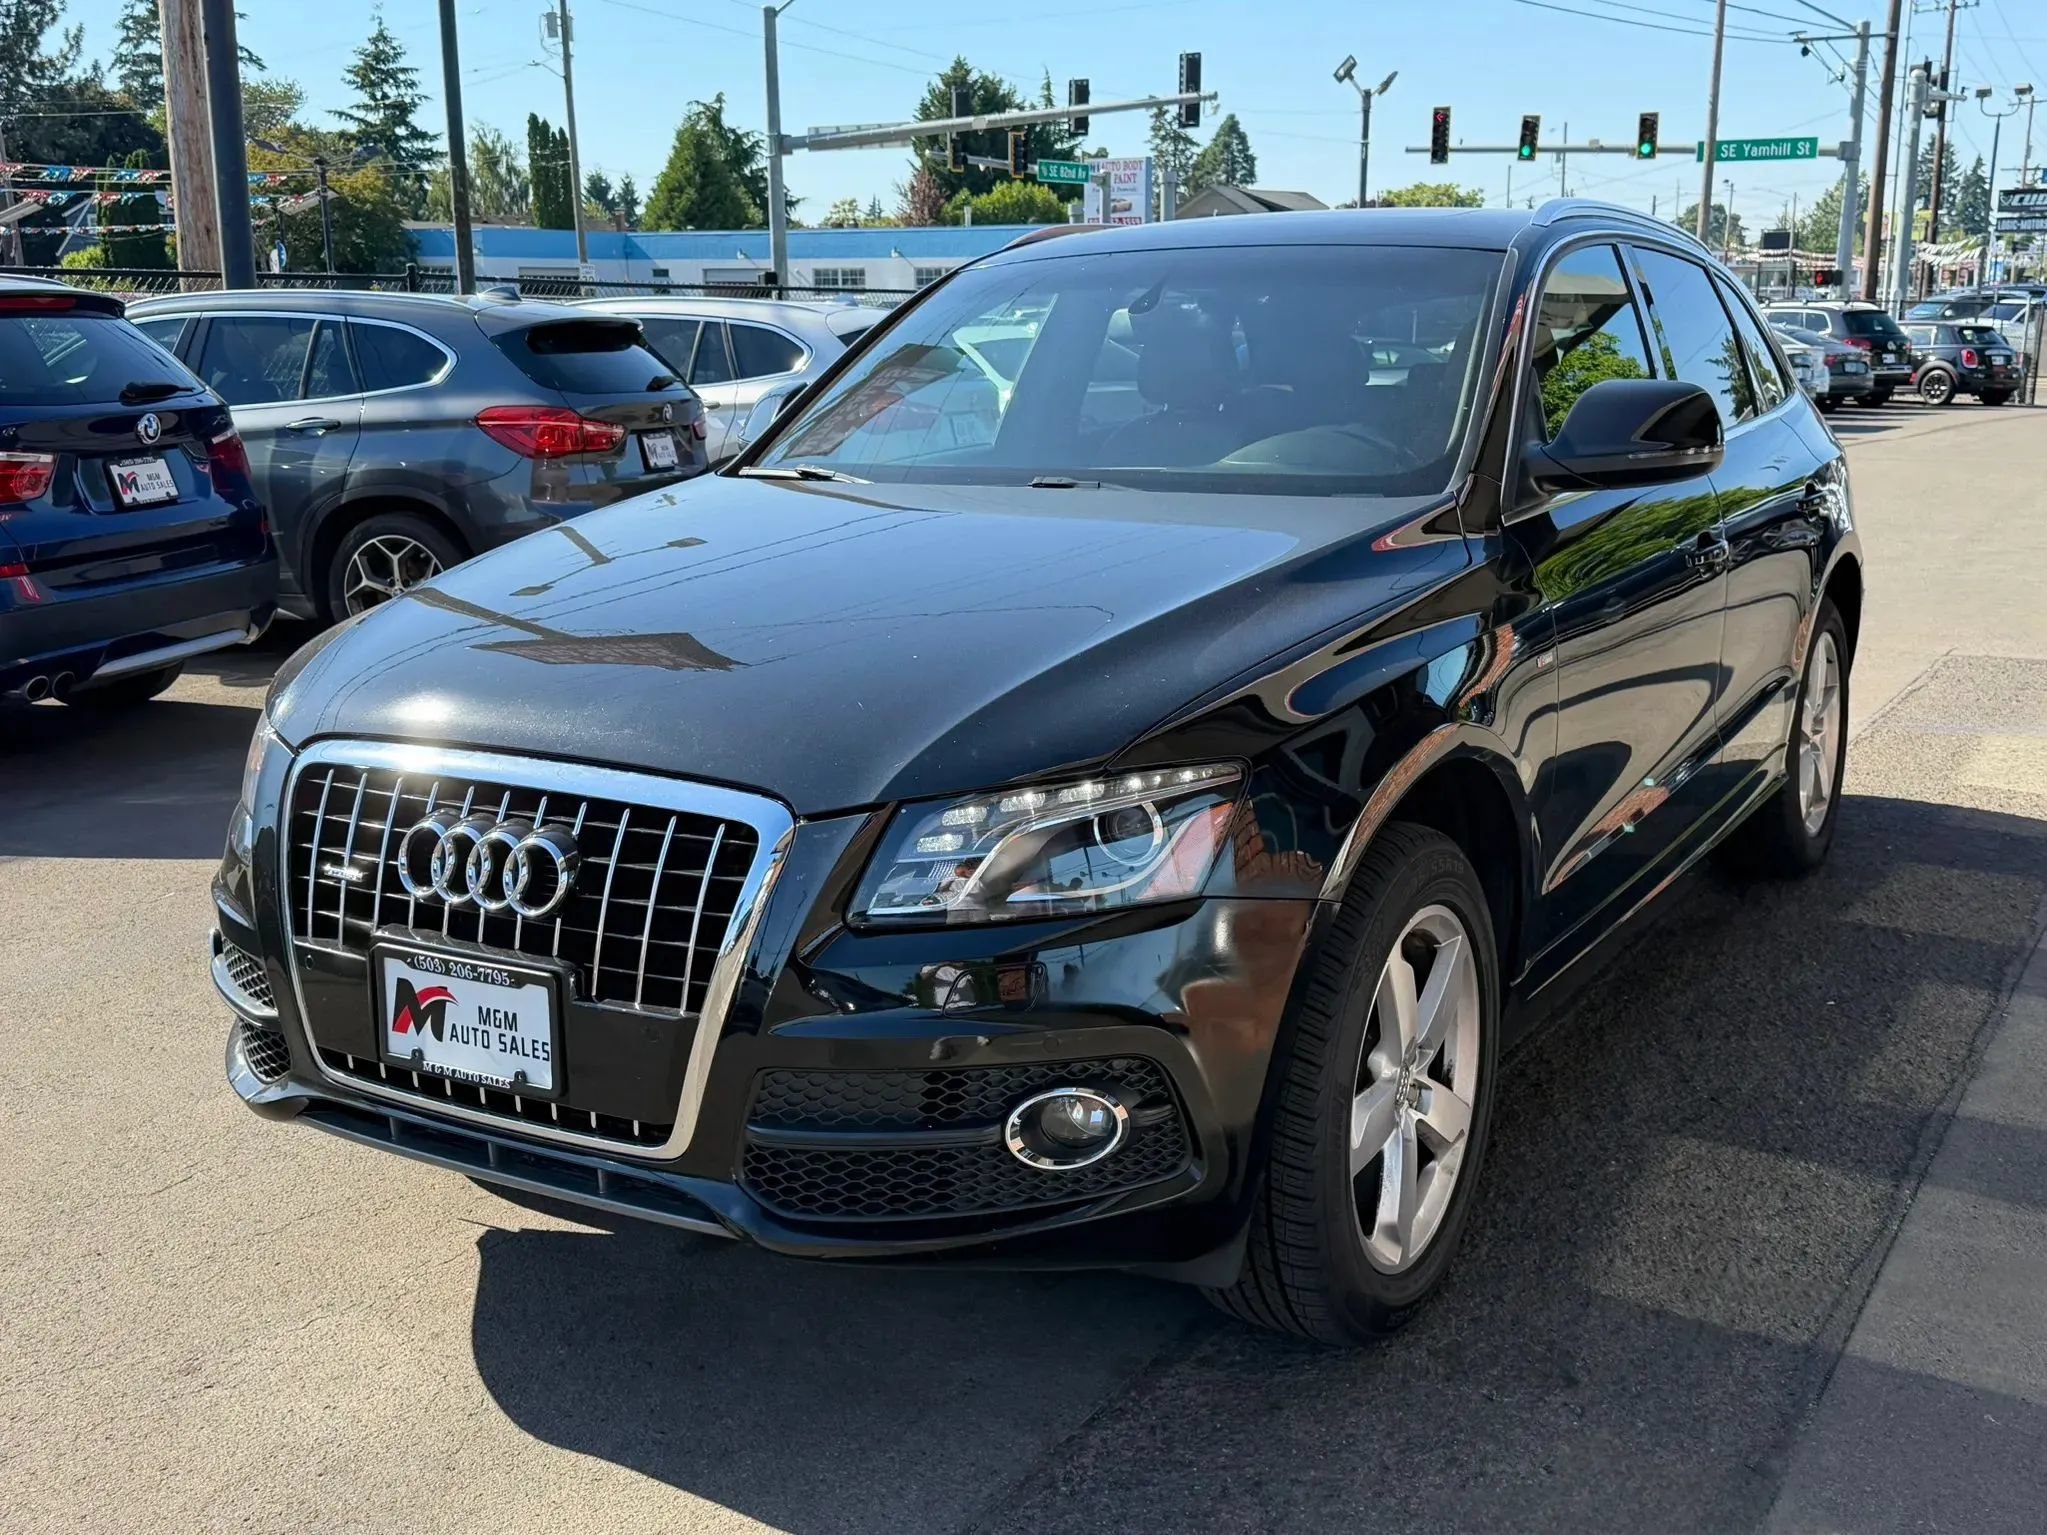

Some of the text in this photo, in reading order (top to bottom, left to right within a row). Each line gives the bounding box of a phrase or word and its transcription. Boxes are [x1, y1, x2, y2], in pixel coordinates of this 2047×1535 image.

[1720, 141, 1810, 158] SE Yamhill St
[1048, 164, 1058, 178] SE
[1122, 160, 1144, 171] BODY
[1114, 172, 1137, 184] PAINT
[413, 954, 510, 986] (503) 206-7795
[477, 1005, 518, 1033] M&M
[449, 1023, 550, 1062] AUTO SALES
[454, 1069, 480, 1083] AUTO
[480, 1074, 511, 1089] SALES
